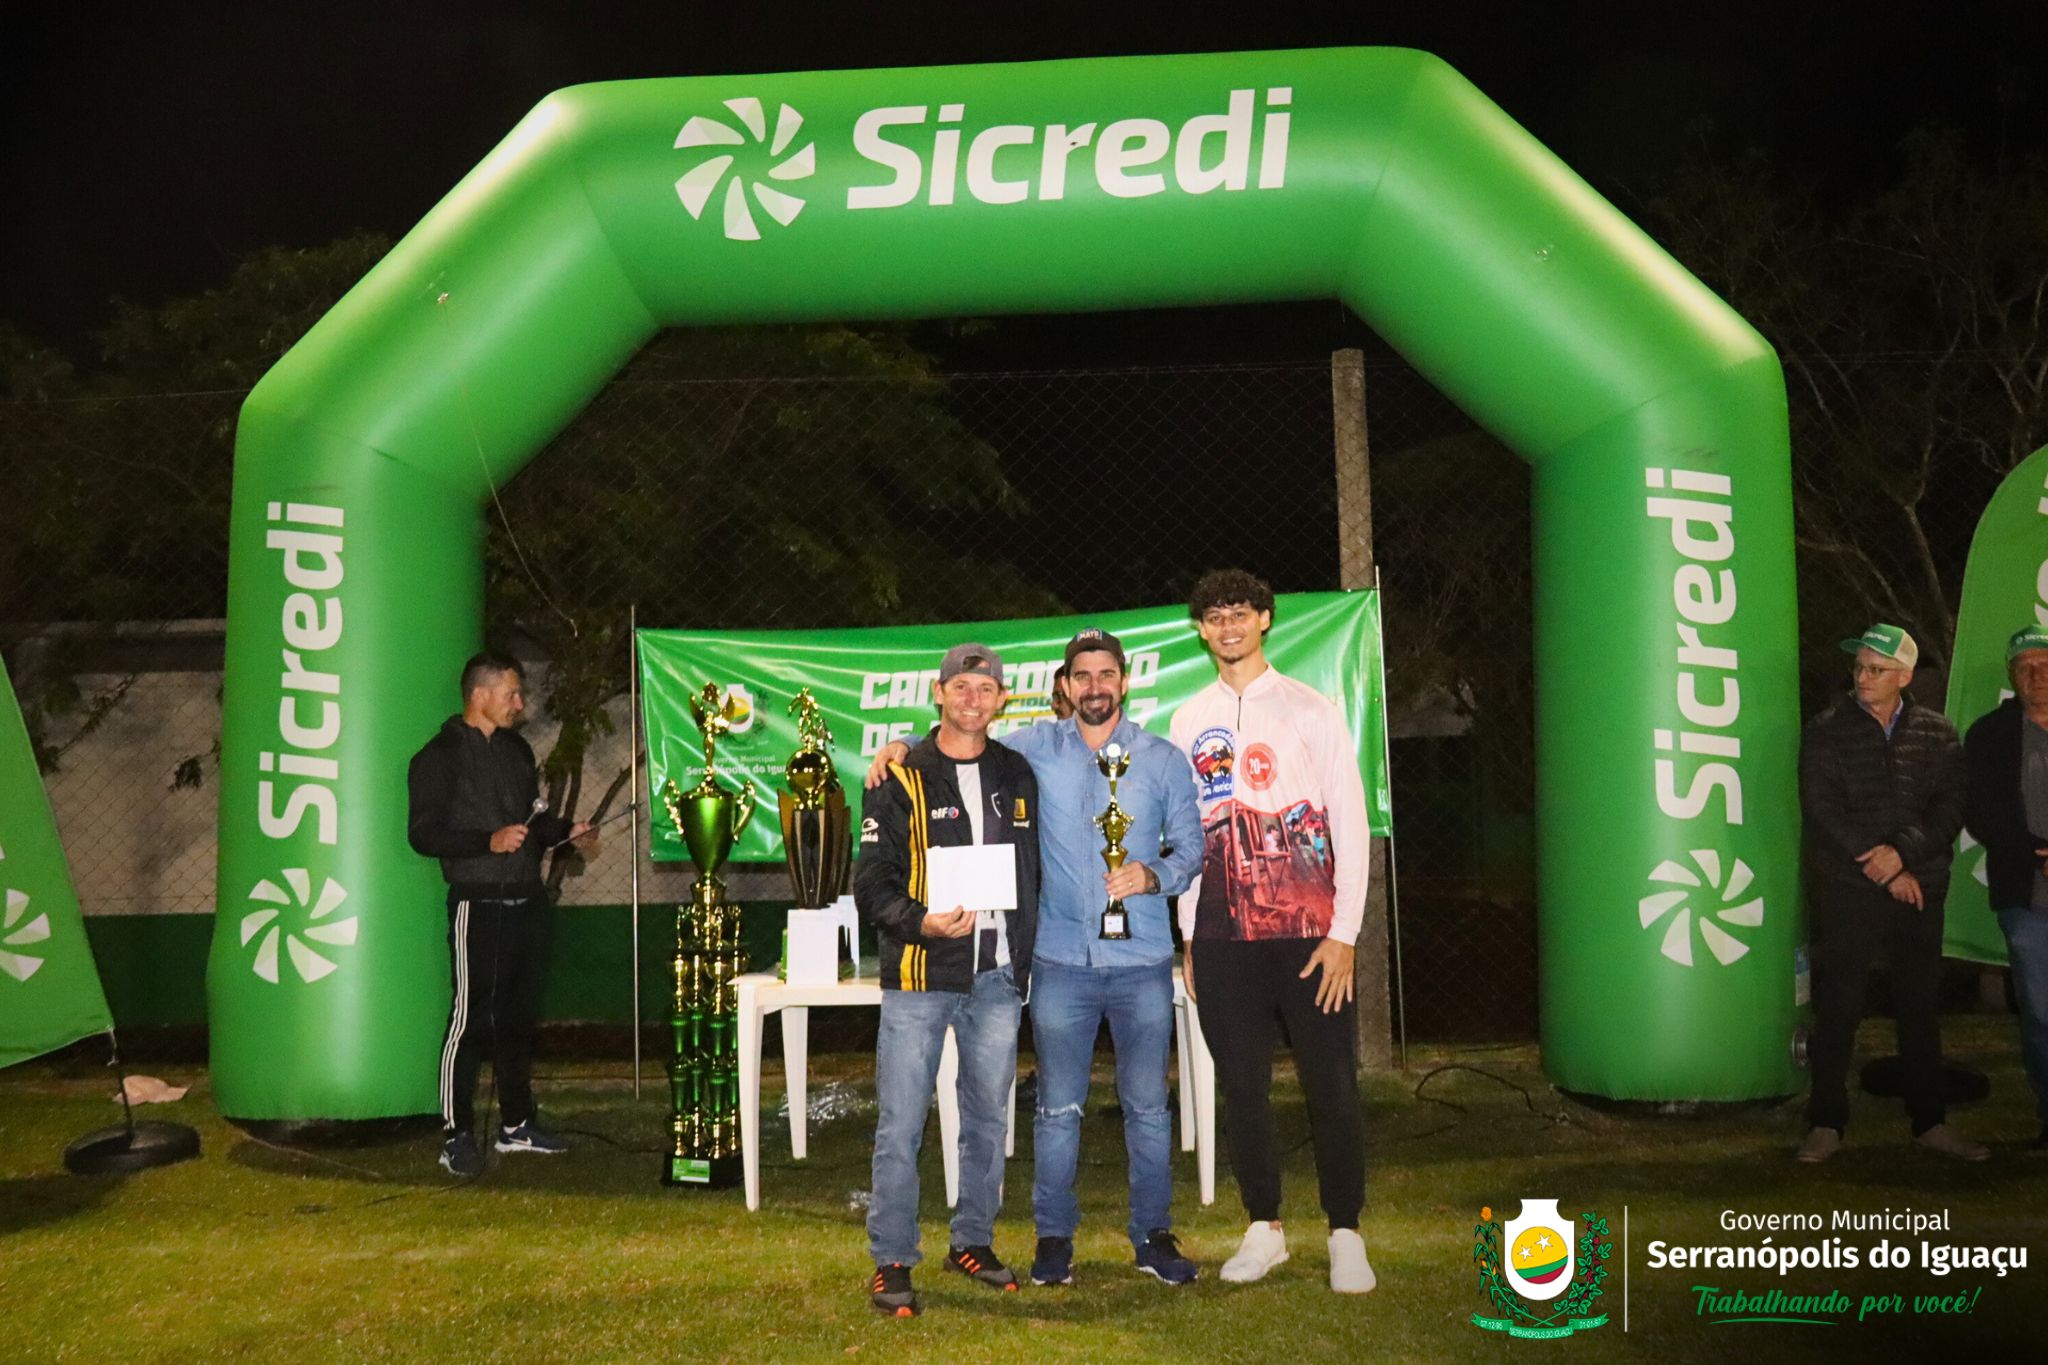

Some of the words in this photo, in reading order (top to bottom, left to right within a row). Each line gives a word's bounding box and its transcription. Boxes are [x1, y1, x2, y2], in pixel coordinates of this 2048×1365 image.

[847, 87, 1292, 209] Sicredi
[258, 502, 344, 844] Sicredi
[1645, 468, 1743, 825] Sicredi
